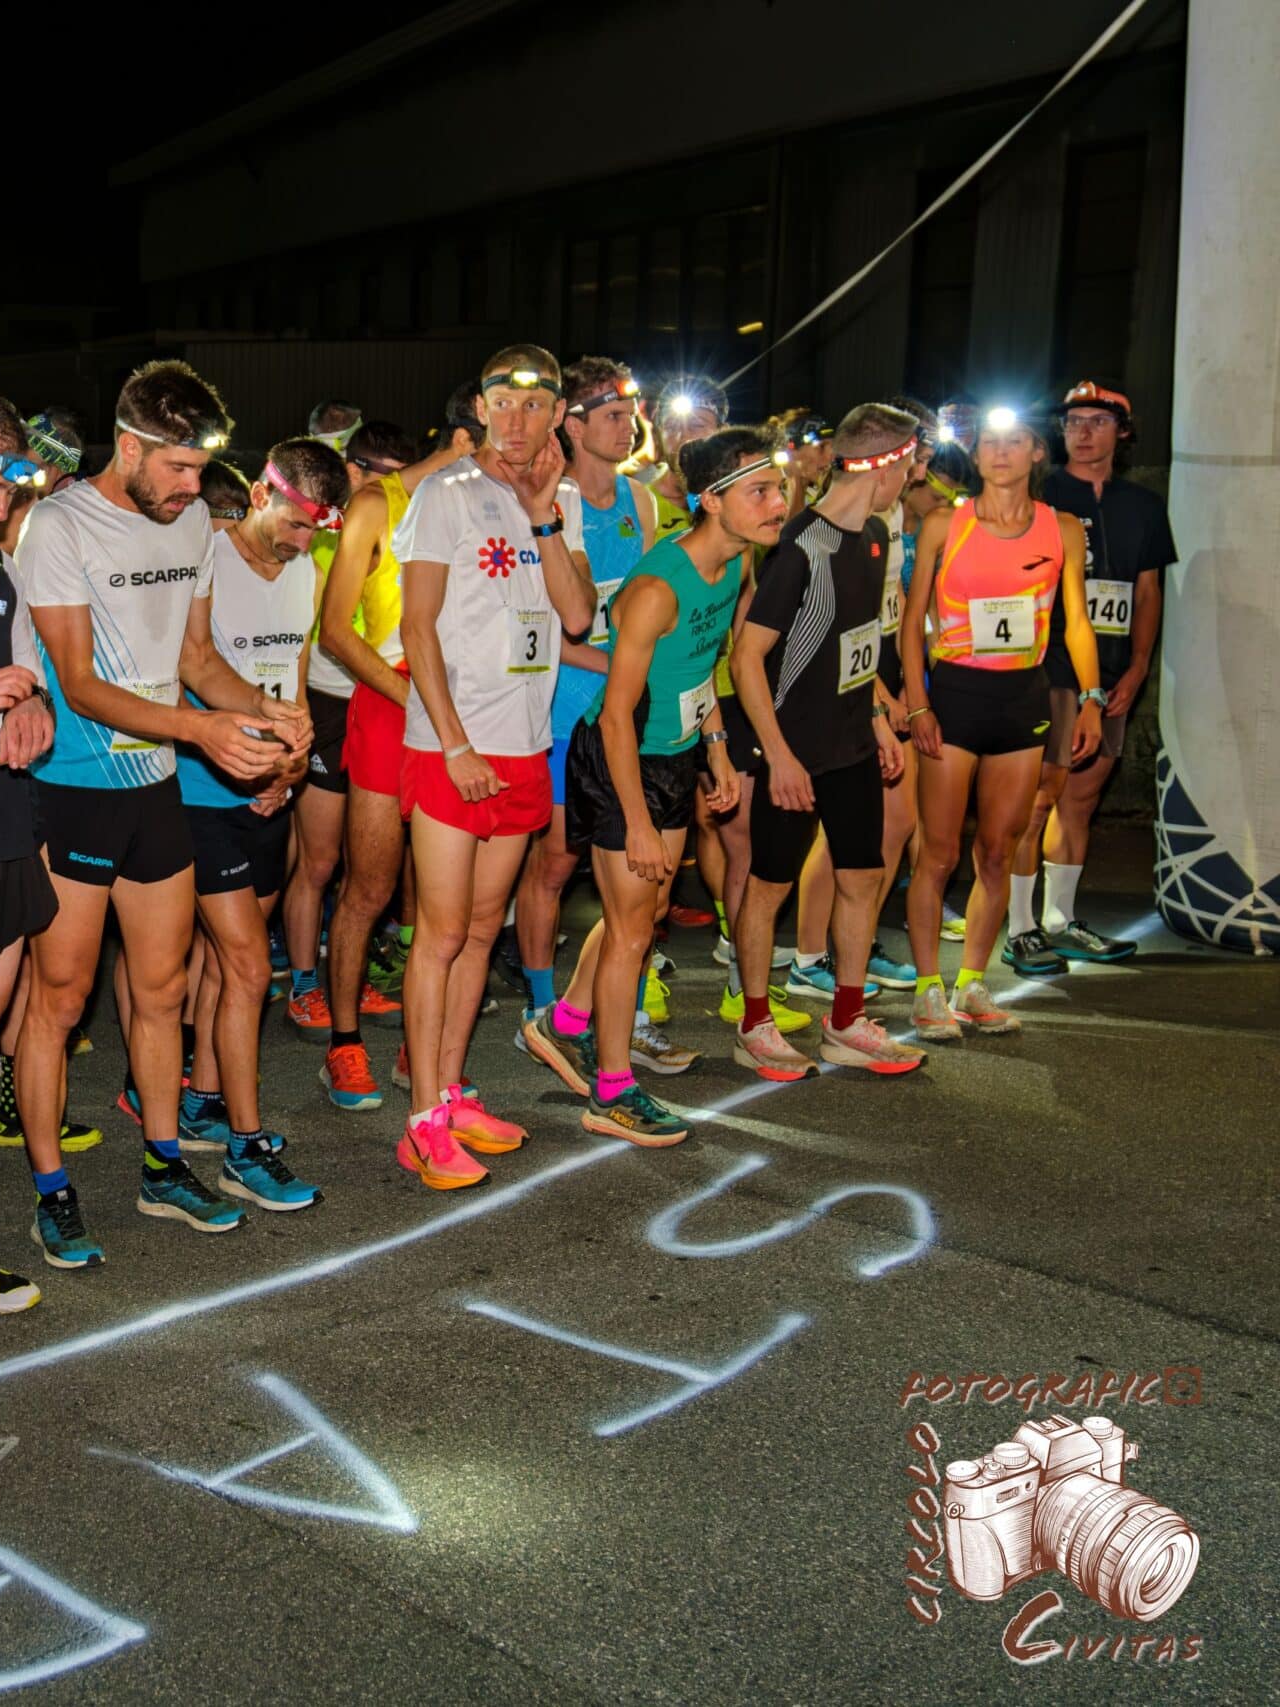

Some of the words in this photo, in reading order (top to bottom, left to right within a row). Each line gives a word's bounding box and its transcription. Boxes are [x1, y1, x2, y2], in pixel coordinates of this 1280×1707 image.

[131, 566, 197, 586] SCARPA
[1088, 597, 1129, 623] 140
[252, 633, 304, 647] SCARPA
[995, 618, 1012, 643] 4
[526, 630, 538, 661] 3
[850, 645, 873, 676] 20
[68, 851, 114, 868] SCARPA
[609, 1109, 636, 1130] HOKA
